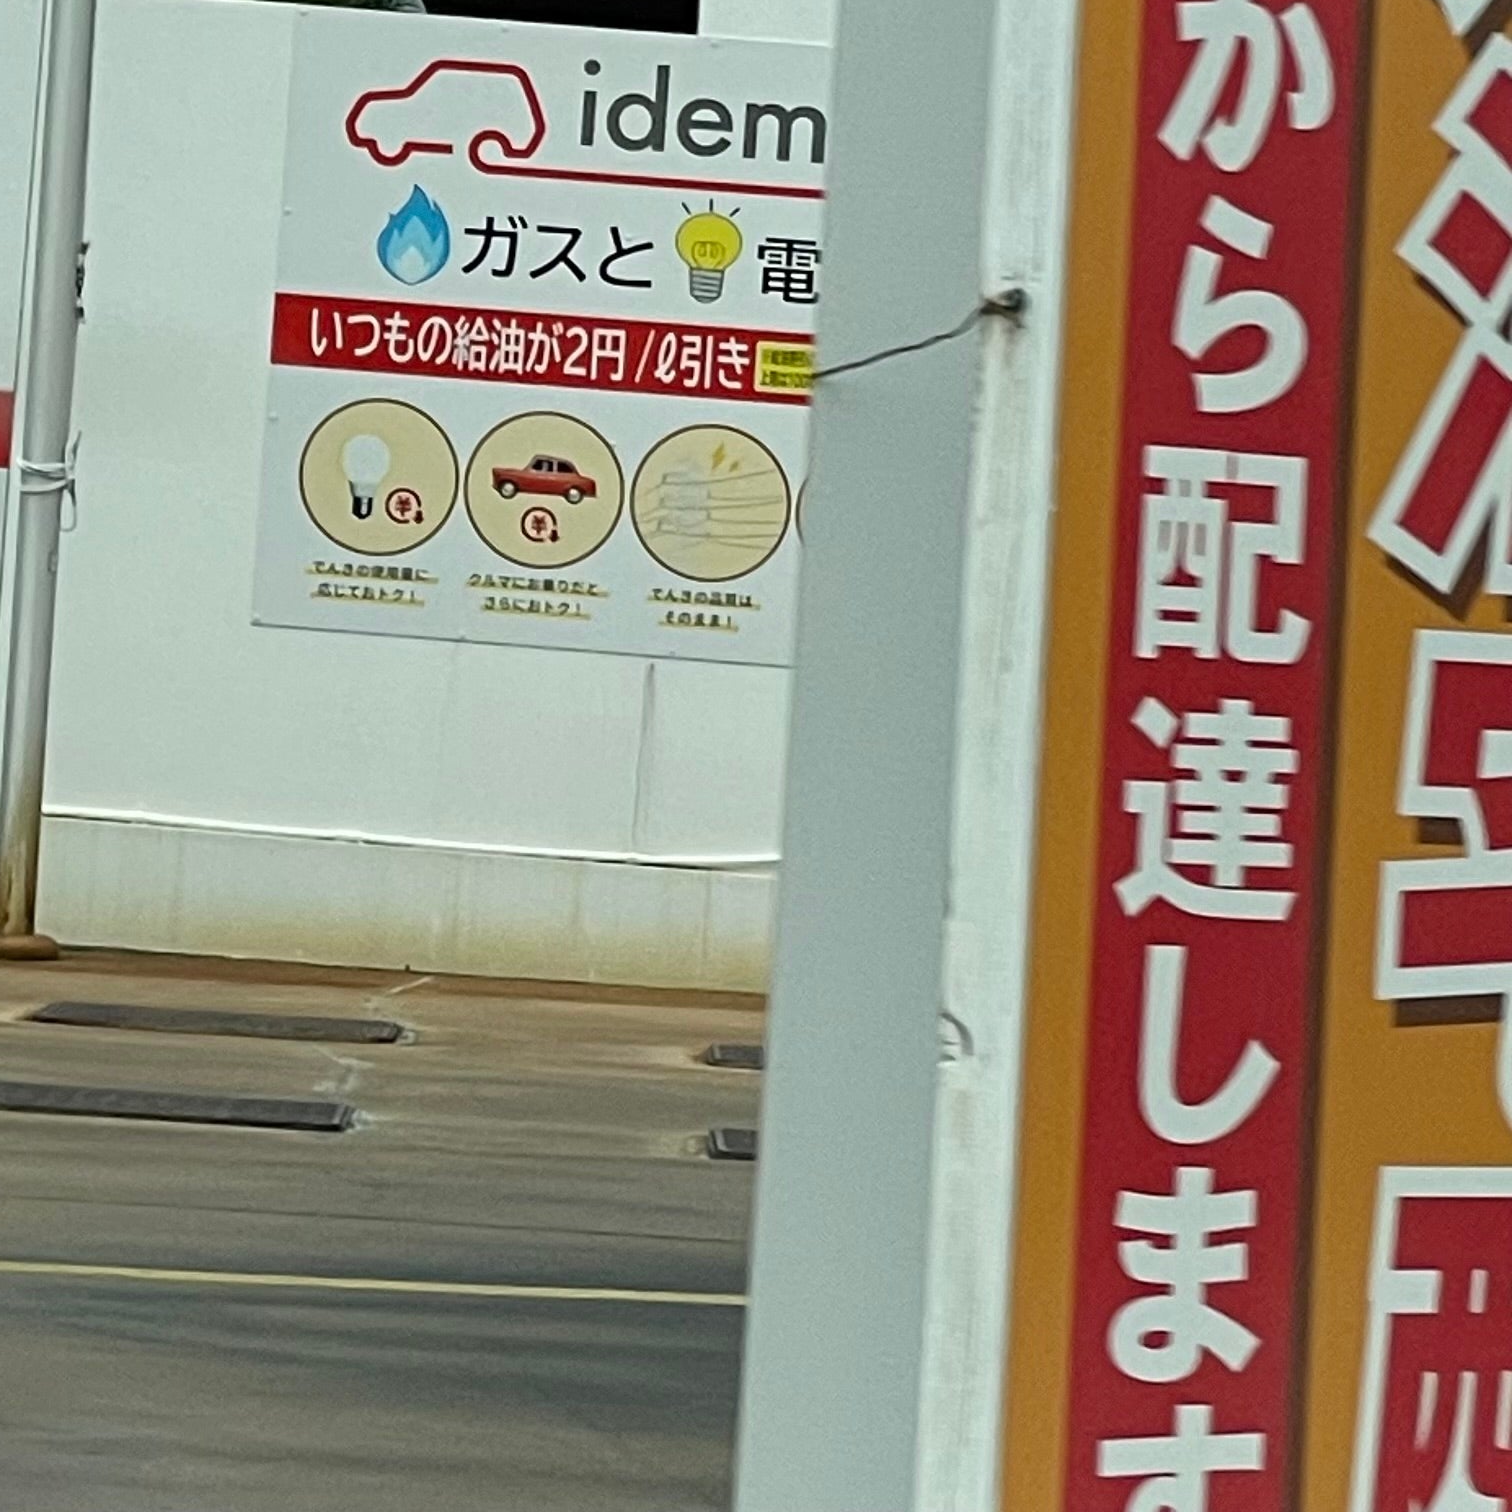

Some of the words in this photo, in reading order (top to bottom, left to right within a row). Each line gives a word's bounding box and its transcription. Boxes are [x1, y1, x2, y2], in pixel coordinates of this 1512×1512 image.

[580, 59, 827, 164] idem
[461, 214, 654, 289] ガスと
